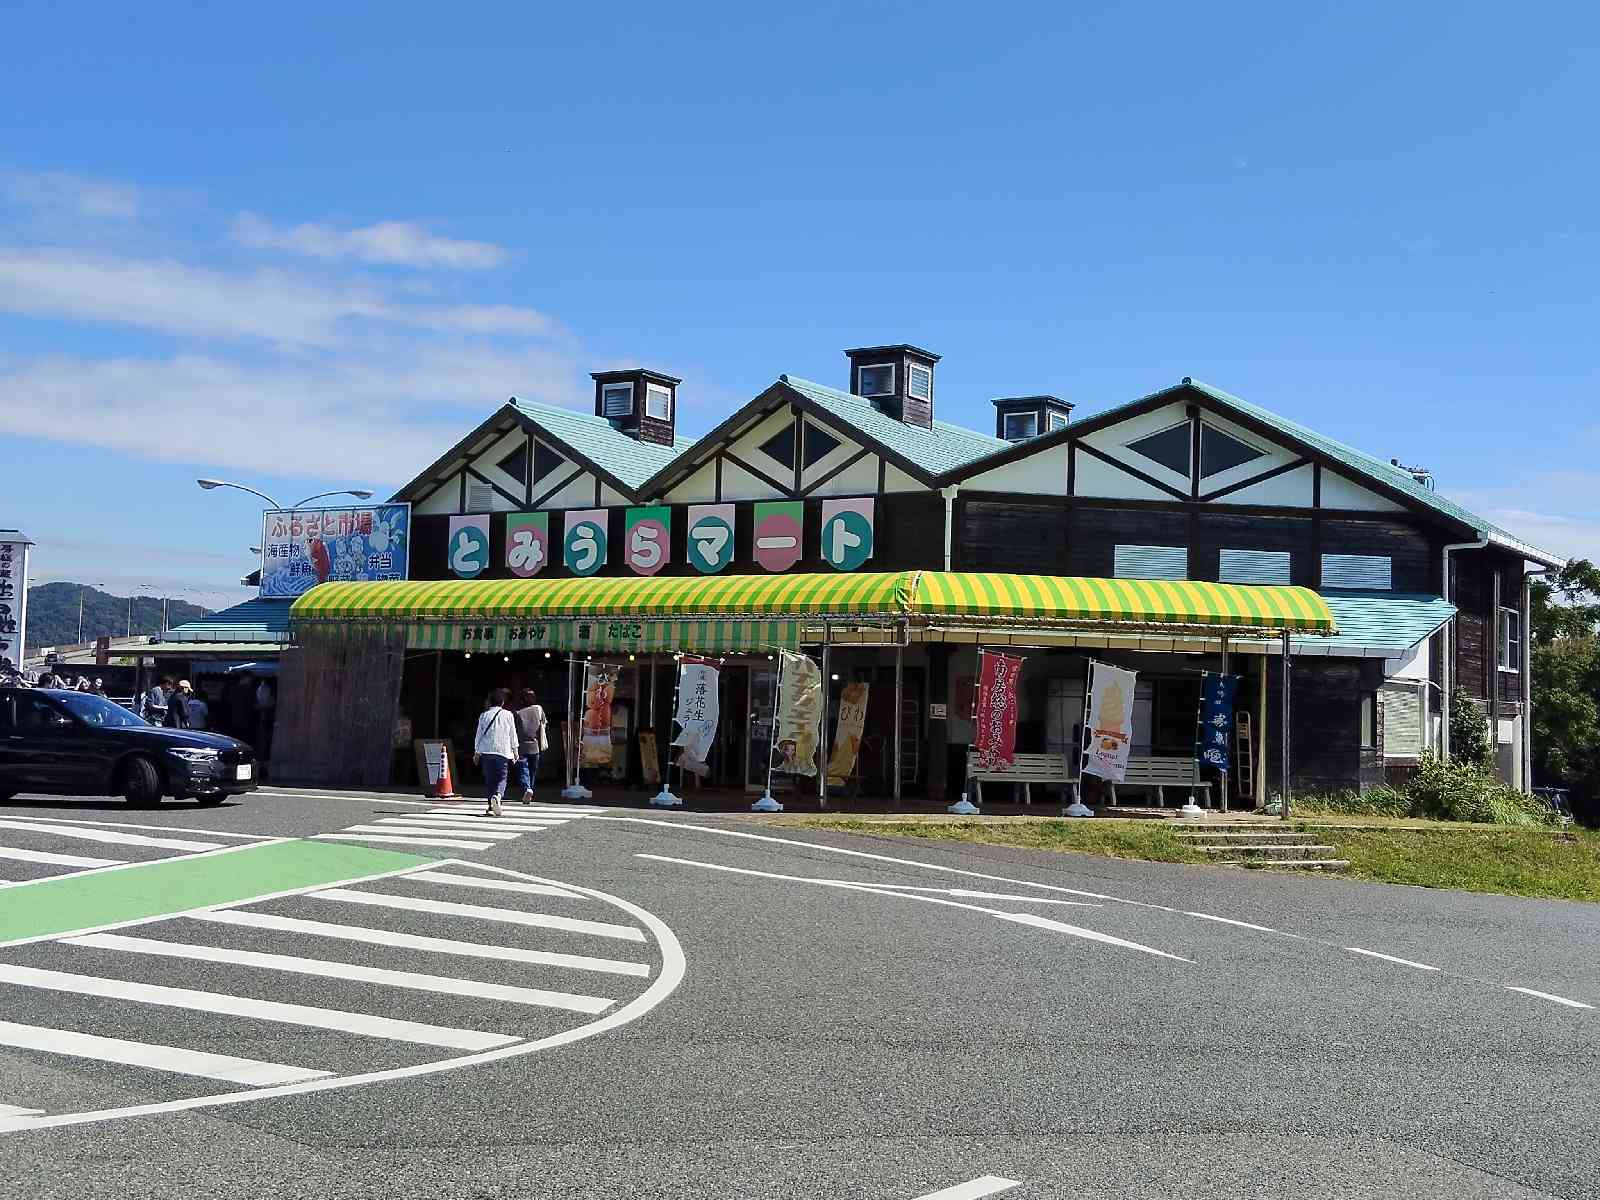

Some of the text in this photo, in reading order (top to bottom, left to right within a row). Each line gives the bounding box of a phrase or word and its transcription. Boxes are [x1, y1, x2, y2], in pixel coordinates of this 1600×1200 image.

[271, 511, 373, 537] ふるさと市場
[267, 543, 300, 558] 海産物
[453, 519, 861, 572] とみうらマート
[289, 561, 312, 577] 鮮魚
[368, 553, 392, 569] 弁当
[608, 623, 642, 640] たばこ
[693, 683, 707, 722] 落花生
